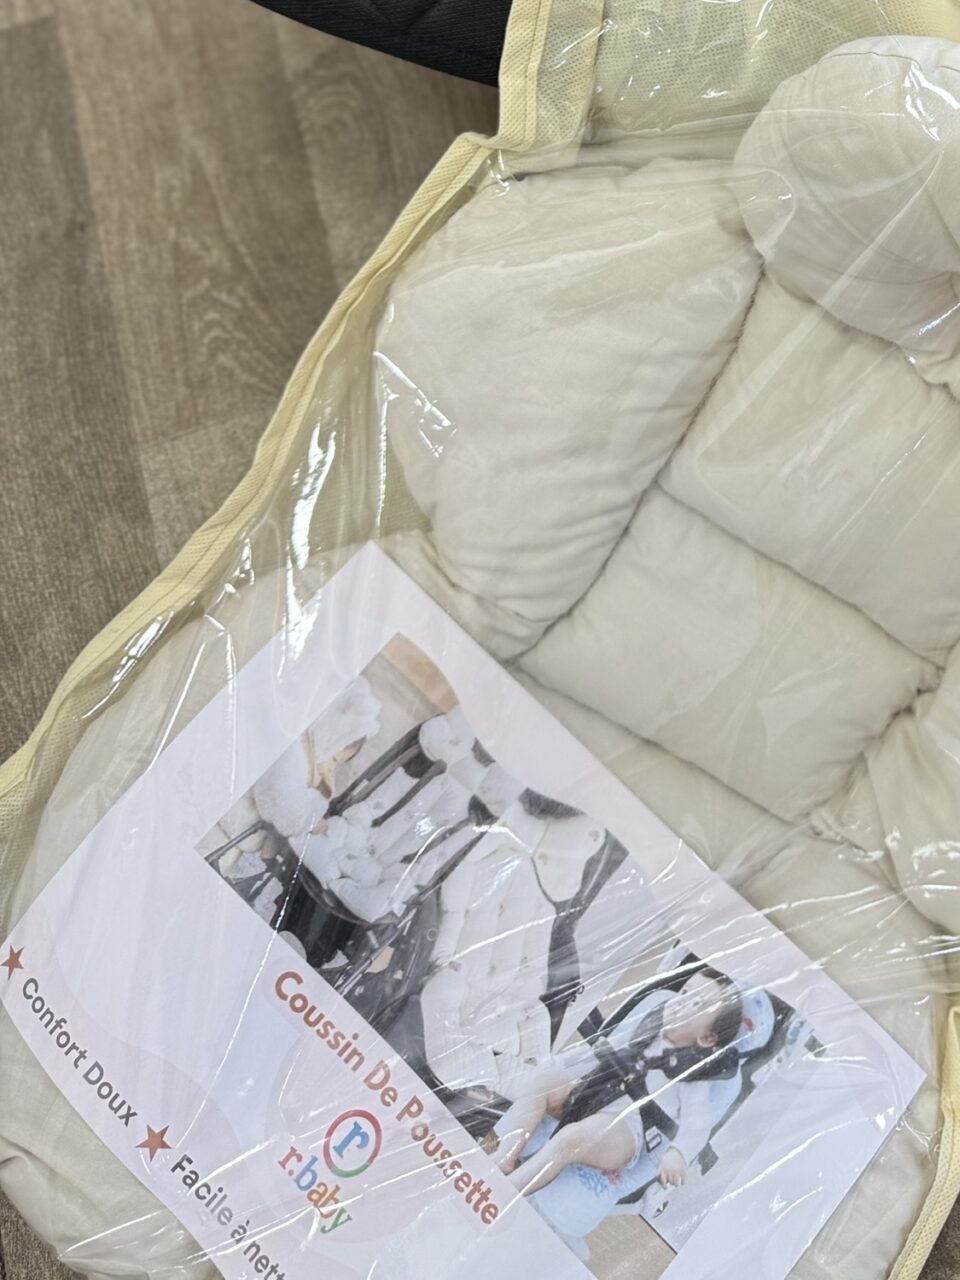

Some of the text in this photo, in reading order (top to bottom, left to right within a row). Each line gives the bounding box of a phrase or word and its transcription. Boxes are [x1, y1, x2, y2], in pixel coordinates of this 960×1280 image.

[22, 977, 138, 1127] Confort Doux
[275, 971, 499, 1225] Coussin De Poussette
[170, 1154, 233, 1226] Facile
